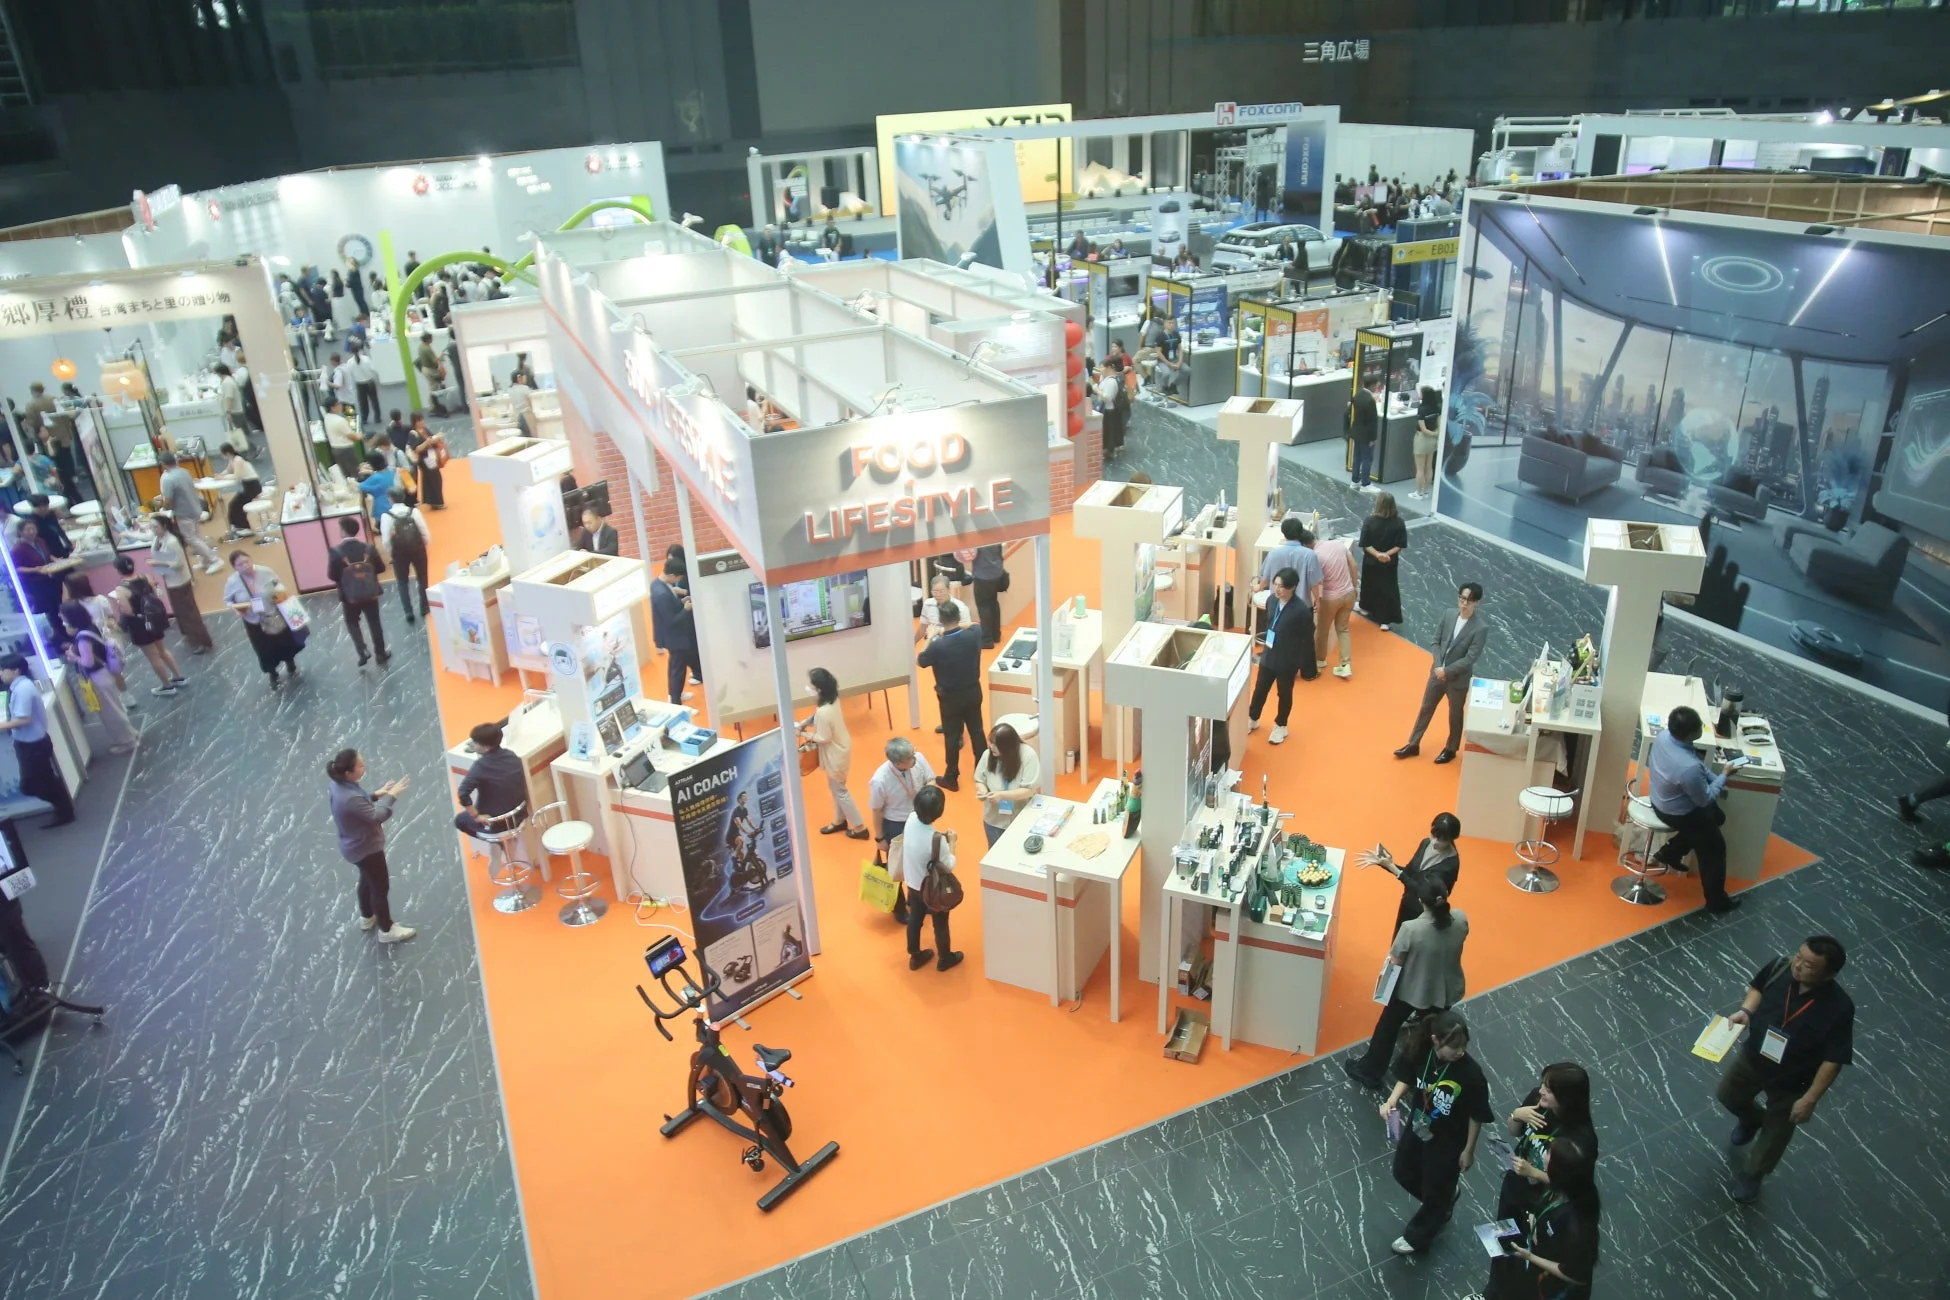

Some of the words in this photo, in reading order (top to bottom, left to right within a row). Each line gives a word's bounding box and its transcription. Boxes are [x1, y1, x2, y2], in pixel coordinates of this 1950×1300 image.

[1302, 39, 1370, 63] 三角広場
[851, 432, 965, 478] FOOD
[804, 477, 1013, 544] LIFESTYLE
[677, 786, 692, 804] AI
[693, 765, 738, 796] COACH
